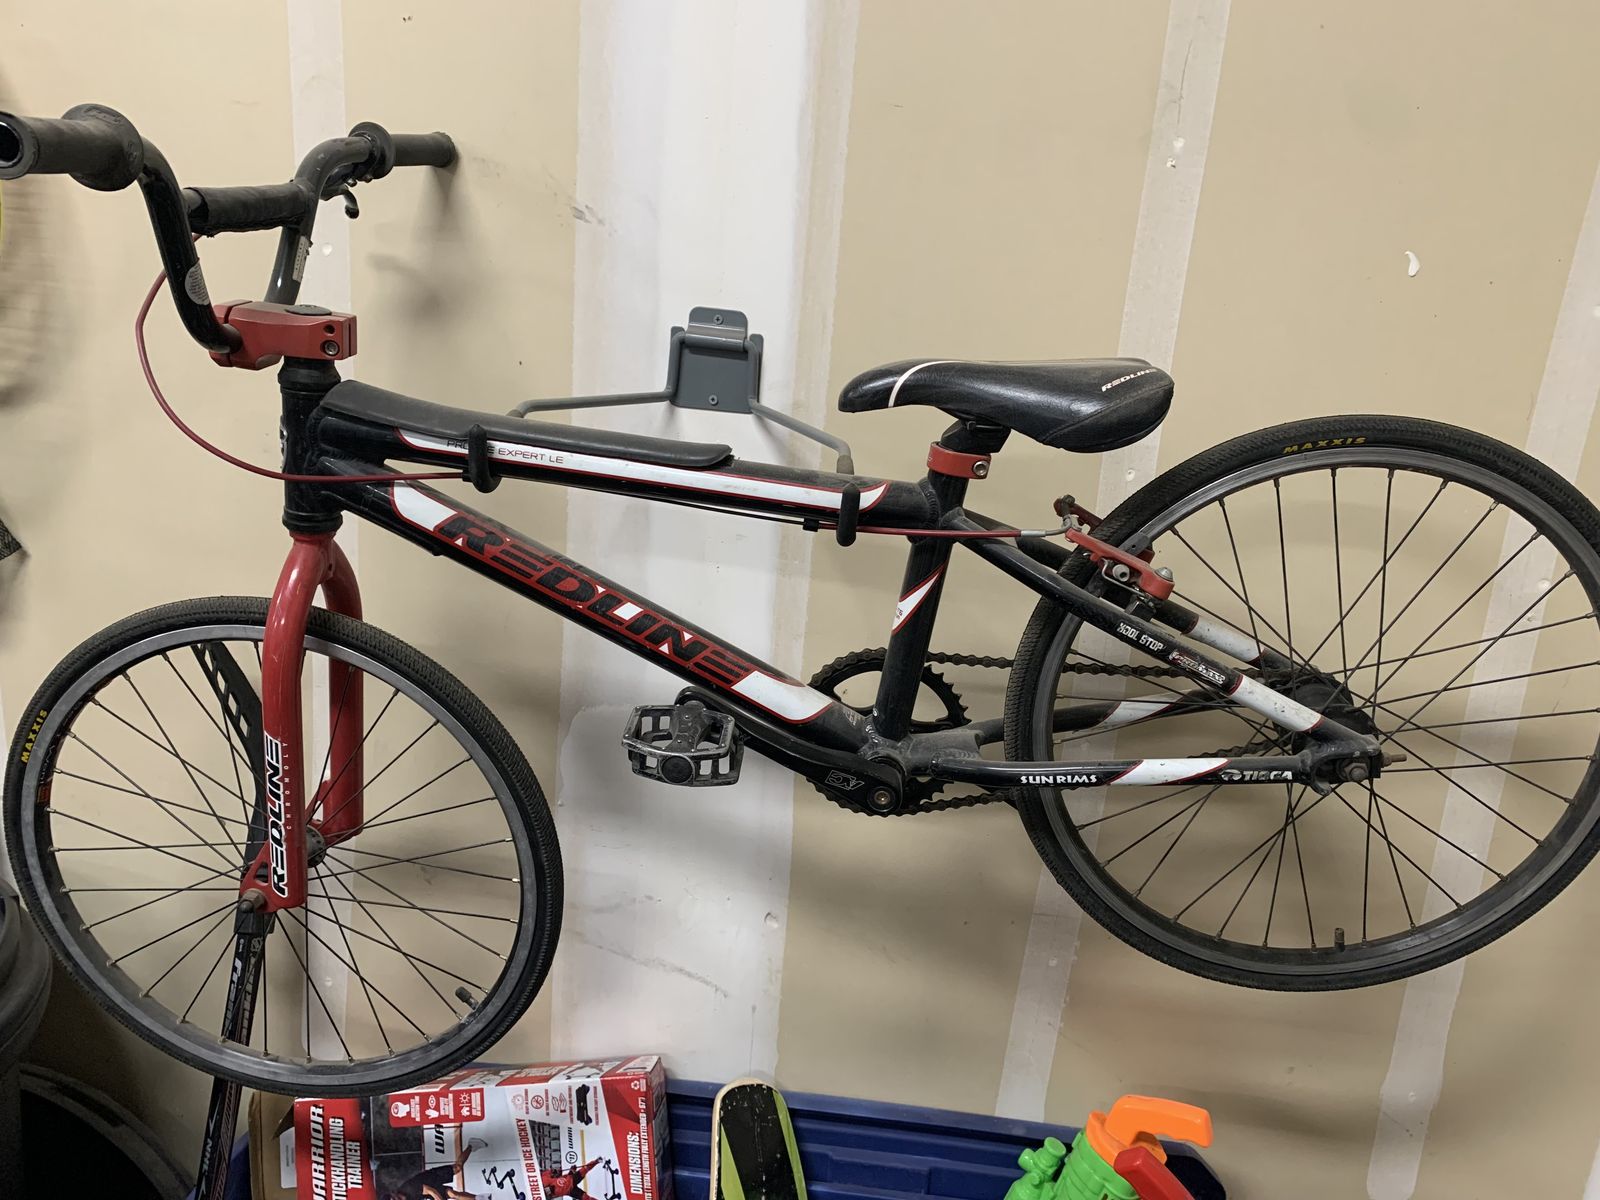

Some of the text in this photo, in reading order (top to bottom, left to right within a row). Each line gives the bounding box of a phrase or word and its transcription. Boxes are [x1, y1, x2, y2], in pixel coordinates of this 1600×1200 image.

[498, 447, 545, 460] EXPERT
[549, 455, 564, 464] LE
[1283, 437, 1367, 454] MAXXIS
[440, 516, 753, 685] REDLINE
[1139, 634, 1164, 652] STOP
[21, 709, 48, 763] MAXXIS
[282, 741, 292, 830] CHROMOLY
[1020, 774, 1098, 785] SUN RIMS
[263, 730, 288, 898] REDLINE
[516, 1118, 531, 1148] HOCKEY
[329, 1117, 347, 1200] TICKHANDLING
[346, 1141, 363, 1189] TRAINER
[522, 1149, 533, 1161] ICE
[525, 1162, 536, 1173] OR
[627, 1131, 643, 1195] DIMENSIONS:
[528, 1174, 543, 1200] STREET
